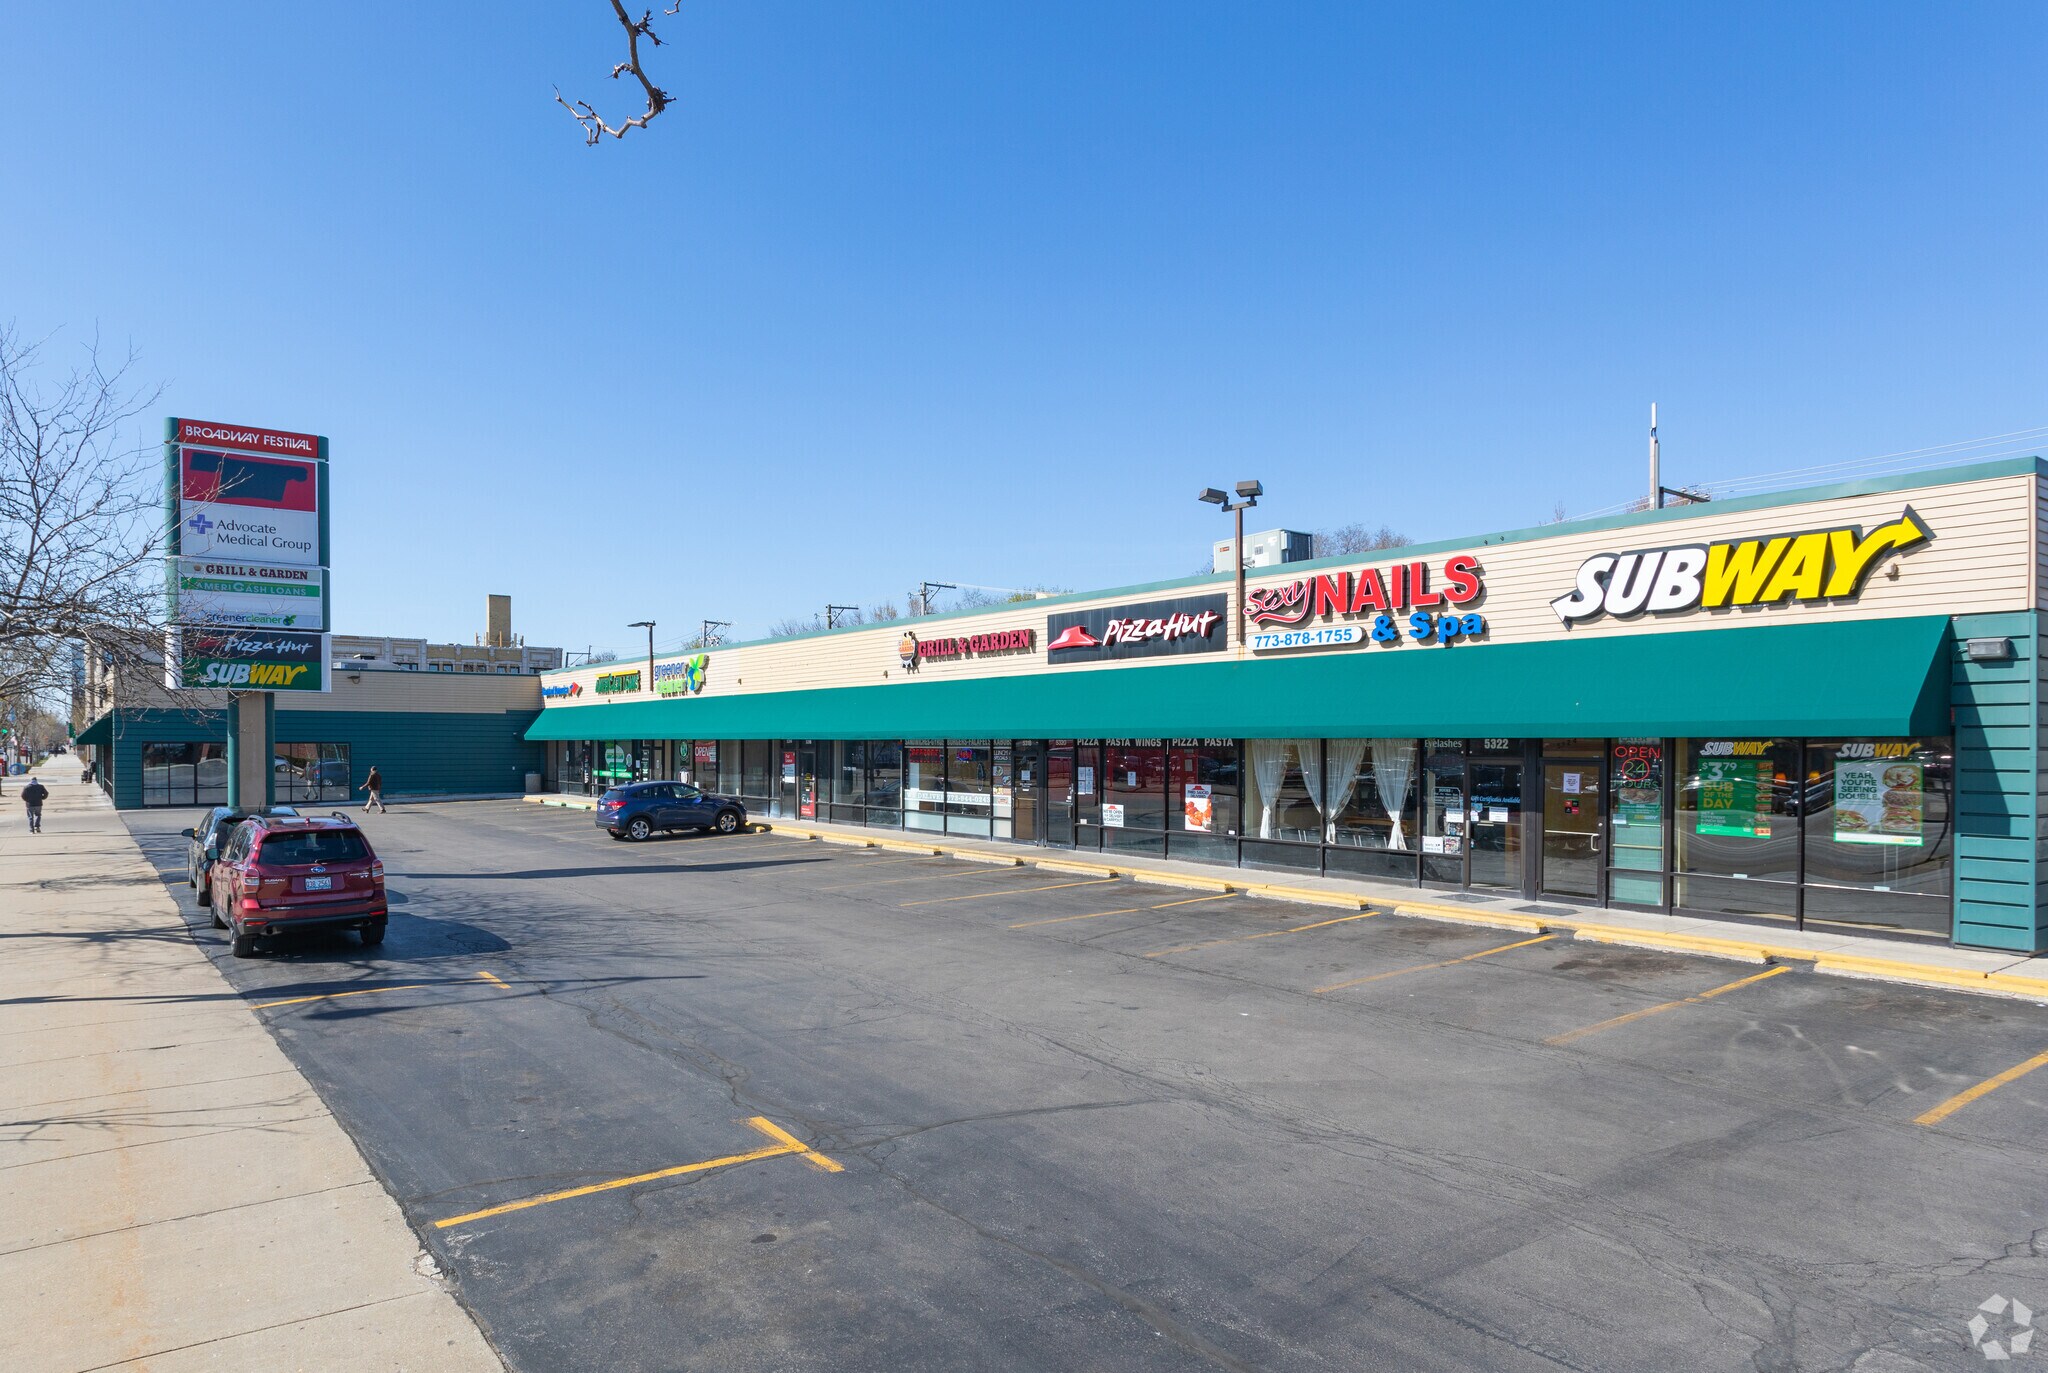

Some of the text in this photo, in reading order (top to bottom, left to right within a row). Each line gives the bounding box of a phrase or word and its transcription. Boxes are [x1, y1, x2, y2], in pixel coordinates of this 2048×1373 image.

[186, 426, 312, 450] BROADWAY FESTIVAL
[216, 520, 276, 534] Advocate
[216, 533, 312, 552] Medical Group
[206, 565, 308, 580] GRILL & GARDEN
[1551, 508, 1930, 626] SUBWAY
[270, 586, 306, 596] LOANS
[1243, 556, 1479, 623] Sexy NAILS
[1102, 610, 1220, 646] Pizza Hut
[1372, 612, 1482, 643] & Spa
[224, 637, 313, 654] Pizza Hut
[918, 629, 1031, 656] GRILL & GARDEN
[1254, 628, 1352, 648] 773-878-1755
[204, 662, 308, 685] SUBWAY
[654, 662, 684, 681] greener
[1077, 738, 1099, 746] PIZZA
[1106, 738, 1162, 747] PASTA WINGS
[1172, 738, 1233, 747] PIZZA PASTA
[1424, 739, 1462, 748] Eyelashes
[1484, 739, 1508, 749] 5322
[1700, 741, 1773, 755] SUBWAY
[1615, 746, 1660, 758] OPEN
[1835, 743, 1920, 758] SUBWAY
[1625, 761, 1646, 776] 24
[1614, 780, 1658, 789] HOURS
[1704, 782, 1733, 792] SUB
[1704, 798, 1733, 808] DAY
